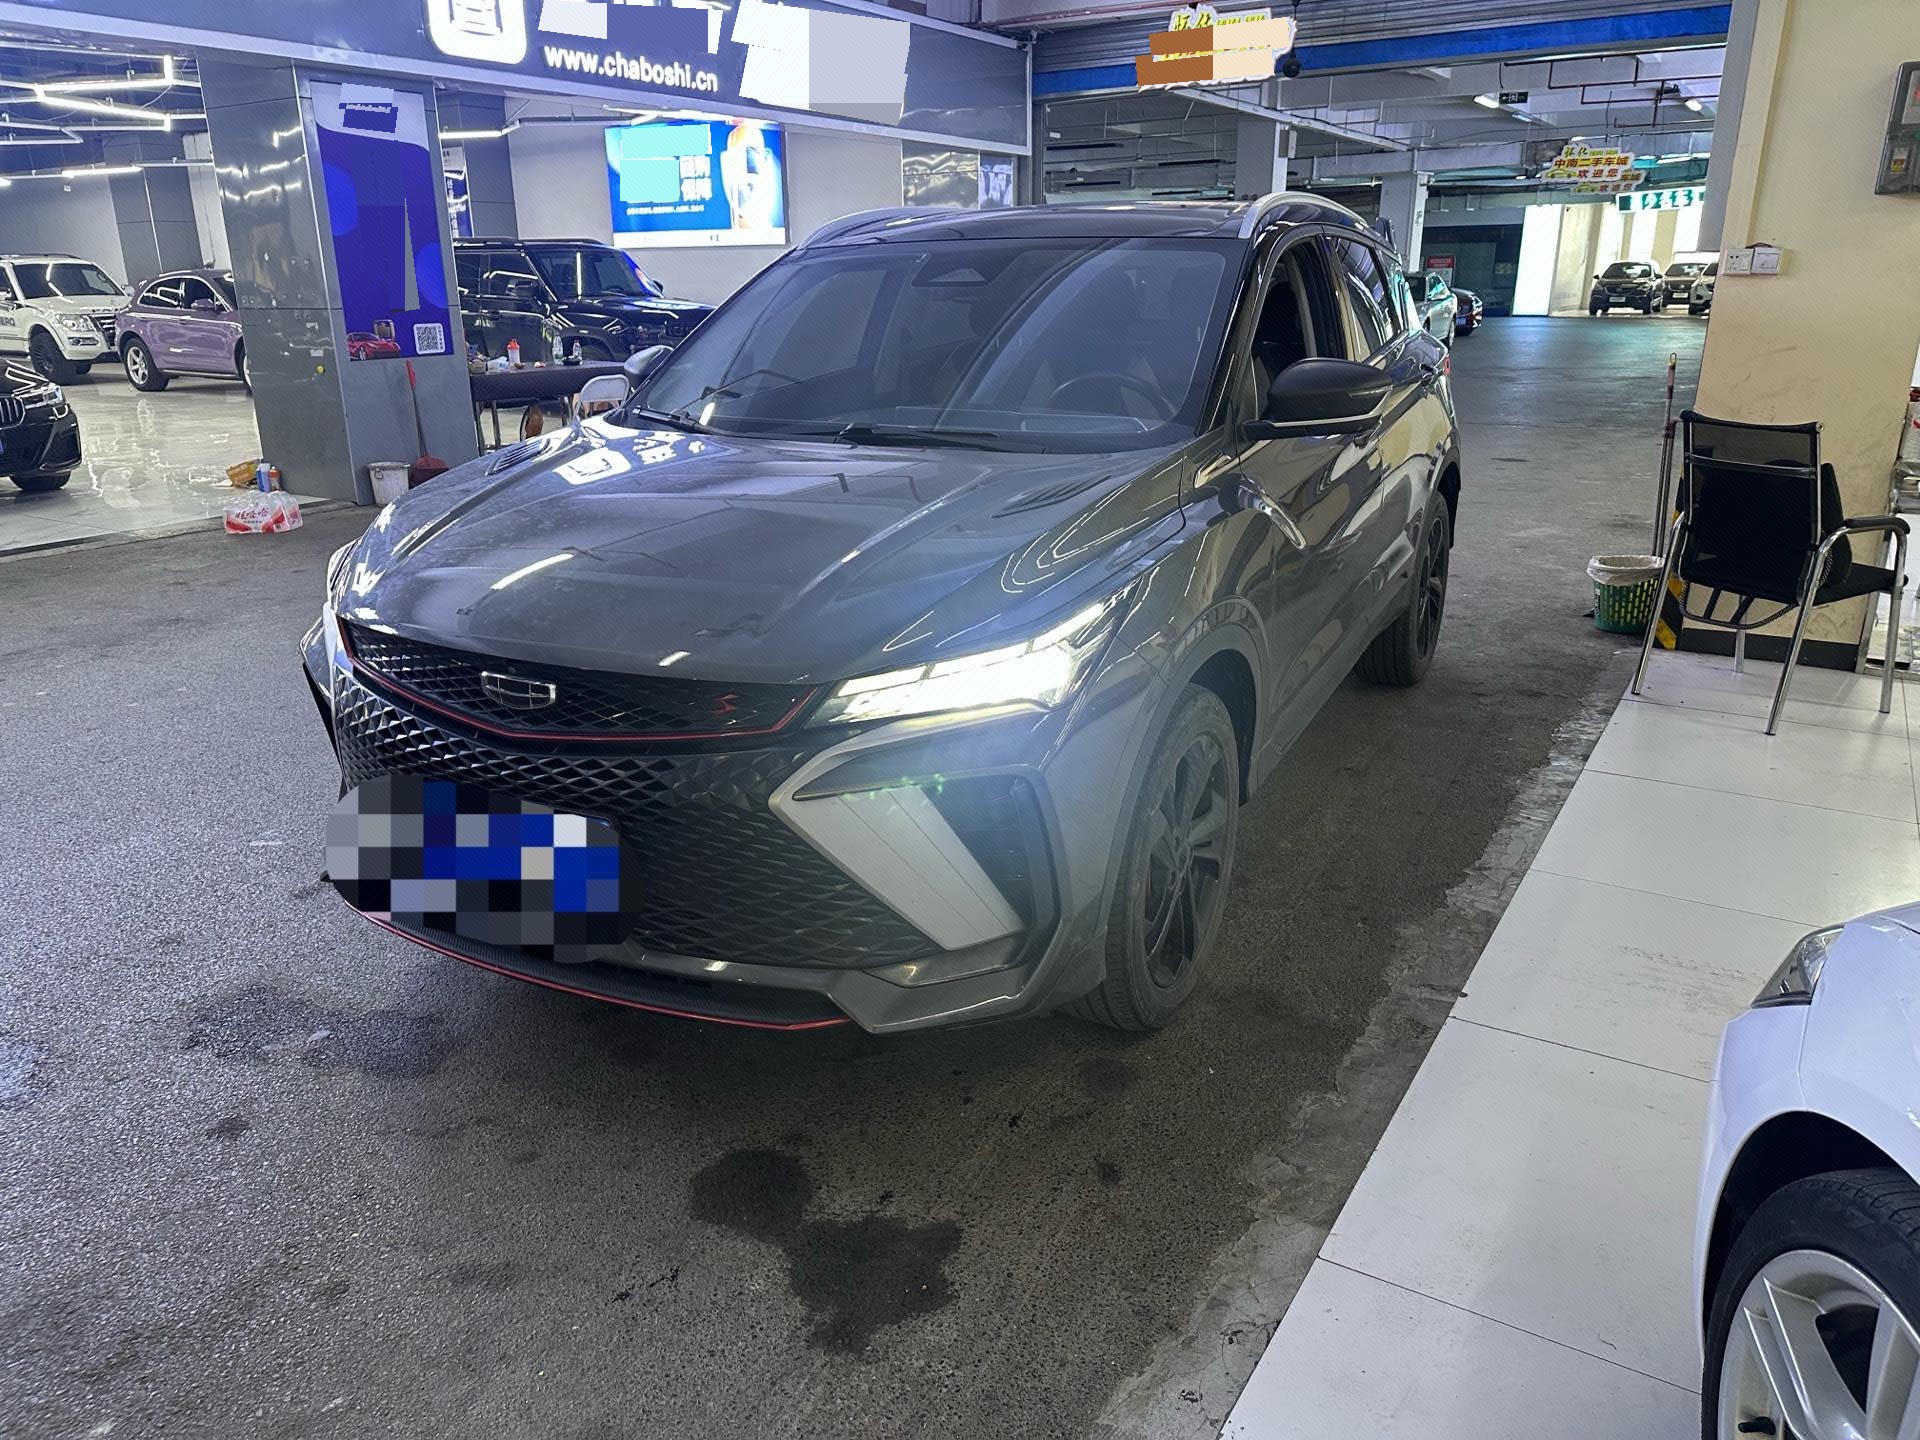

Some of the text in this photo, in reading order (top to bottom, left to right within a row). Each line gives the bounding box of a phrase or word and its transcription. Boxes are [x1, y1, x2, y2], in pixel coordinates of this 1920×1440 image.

[543, 45, 719, 92] www.chaboshi.cn
[1554, 156, 1629, 168] 中南二手车城
[1577, 168, 1619, 178] 欢迎您
